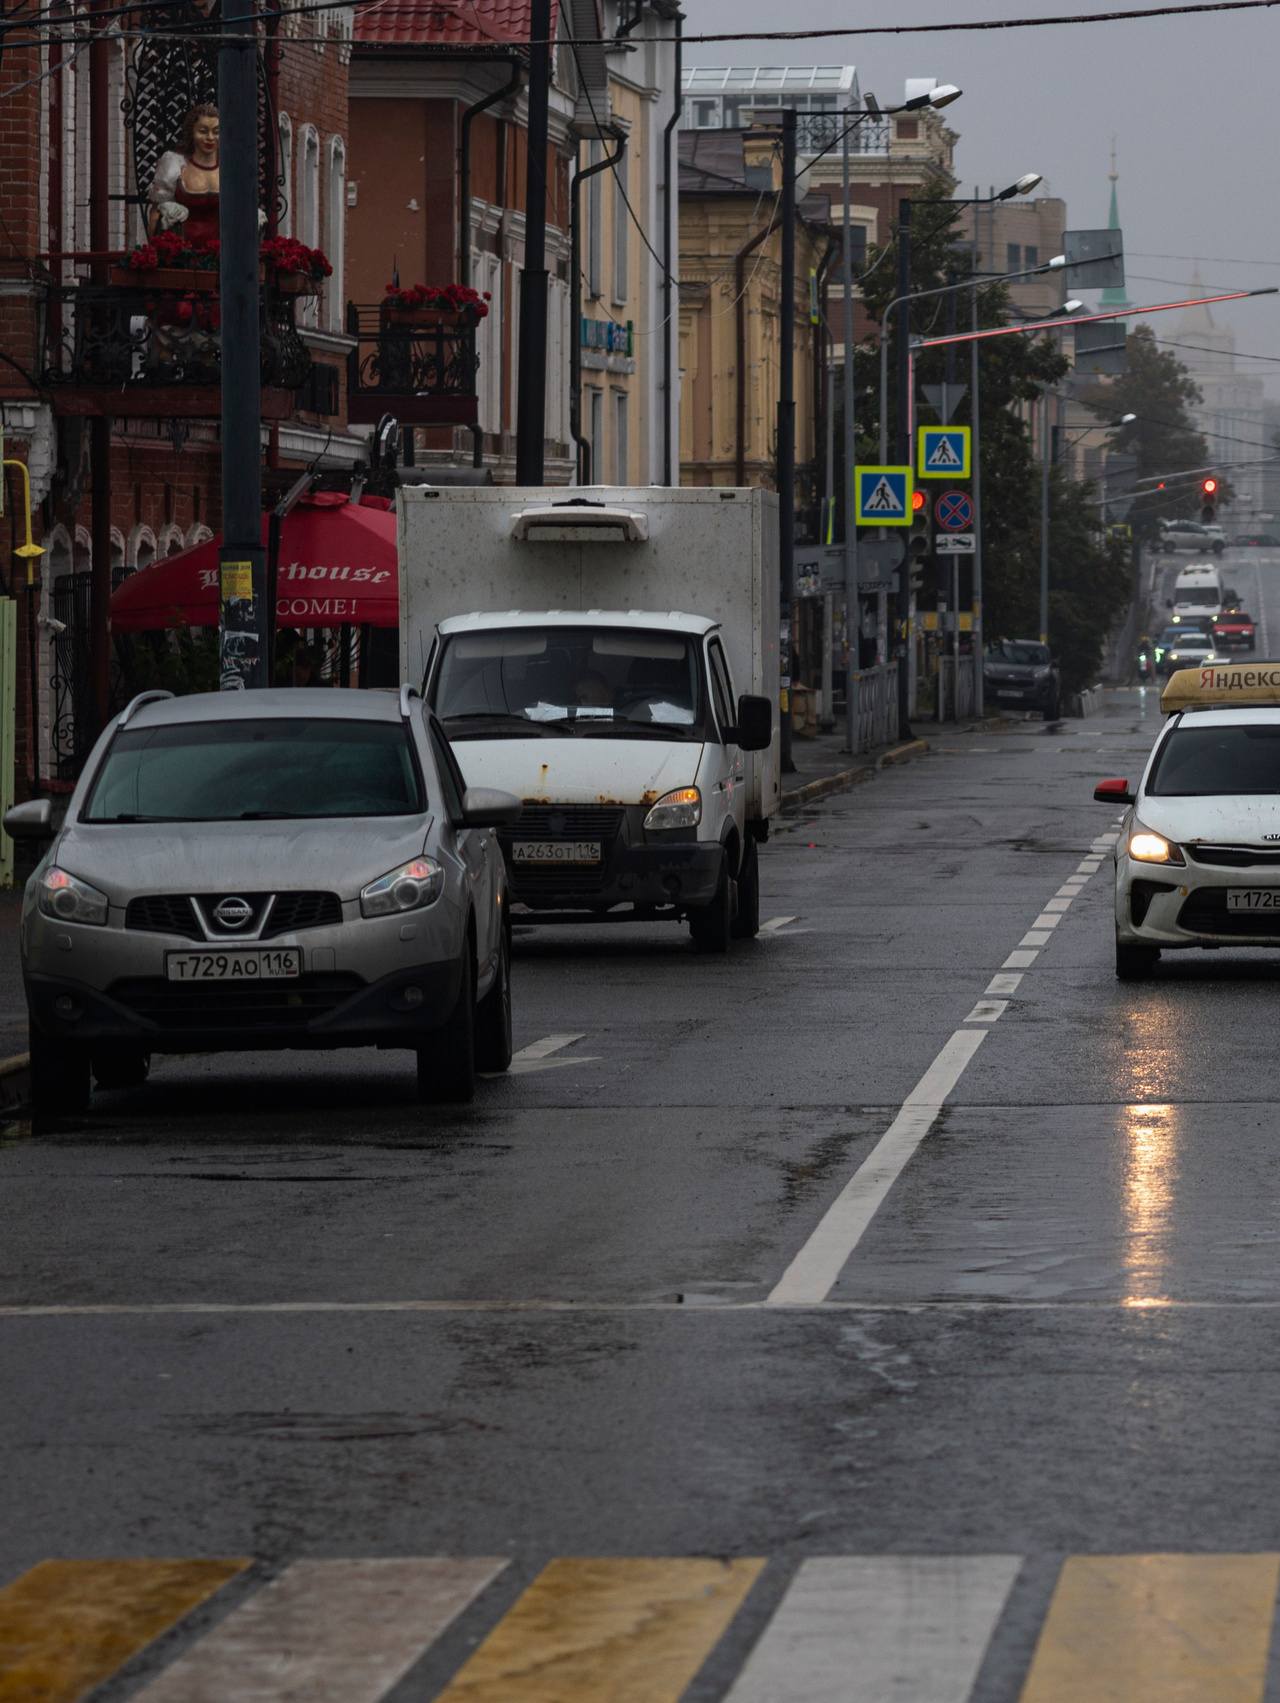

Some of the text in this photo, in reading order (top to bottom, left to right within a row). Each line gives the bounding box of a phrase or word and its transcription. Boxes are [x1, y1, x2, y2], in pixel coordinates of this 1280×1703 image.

[1200, 669, 1280, 690] Яндекс
[577, 843, 597, 854] 116
[263, 953, 293, 969] 116
